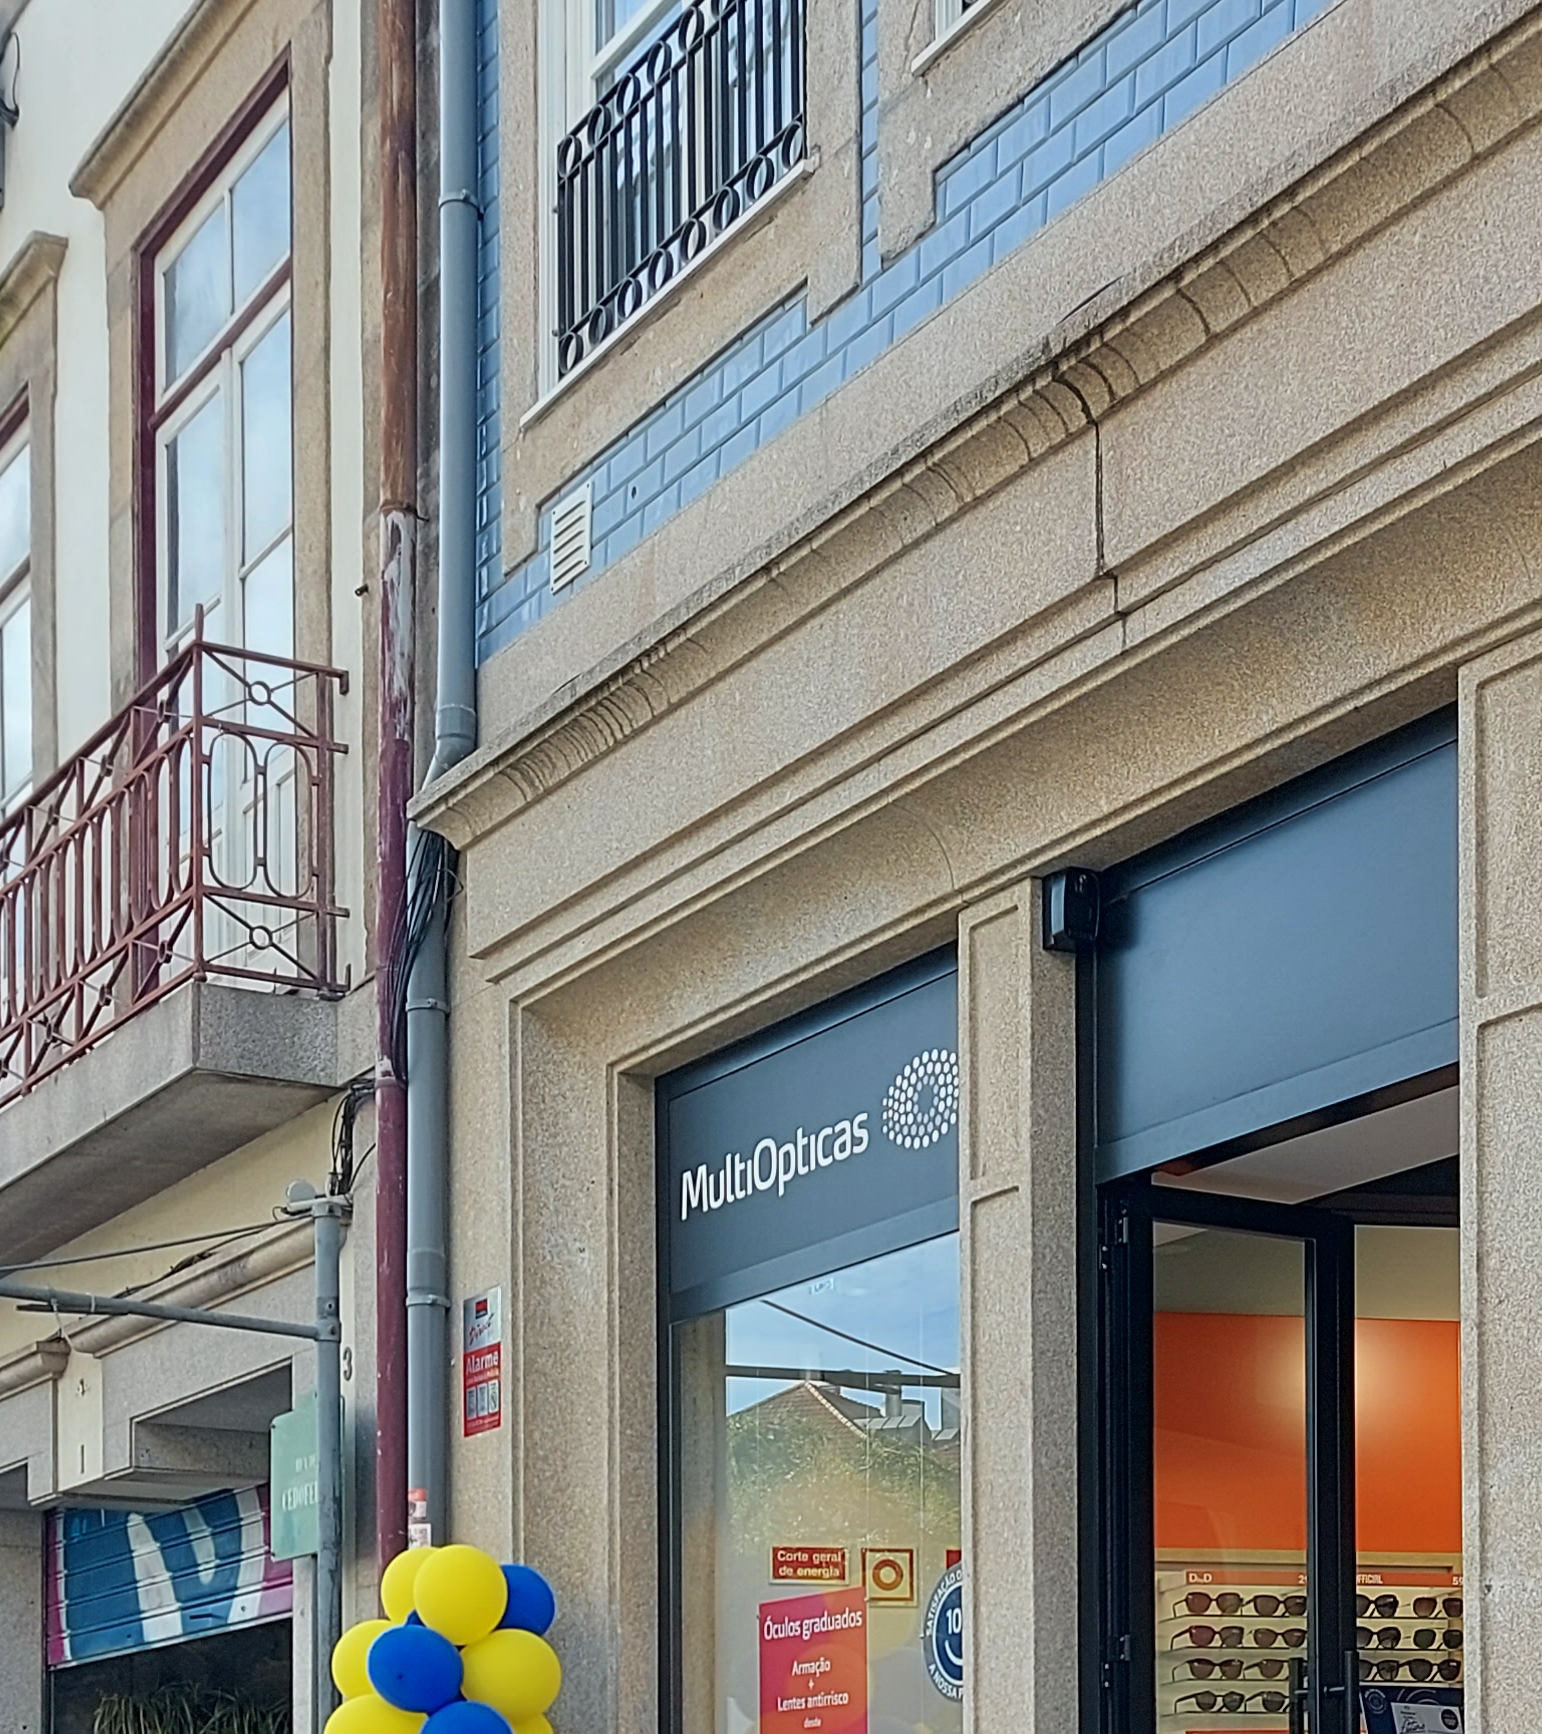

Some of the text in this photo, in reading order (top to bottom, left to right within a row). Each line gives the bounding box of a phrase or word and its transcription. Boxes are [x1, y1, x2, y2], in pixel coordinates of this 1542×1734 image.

[680, 1112, 869, 1221] MultiOpticas
[777, 1550, 841, 1564] Corte geral
[778, 1565, 839, 1579] de energia
[764, 1607, 863, 1640] Óculos graduados
[946, 1607, 962, 1635] 10
[792, 1657, 831, 1677] Armação
[777, 1690, 849, 1712] Lentes antirrisco
